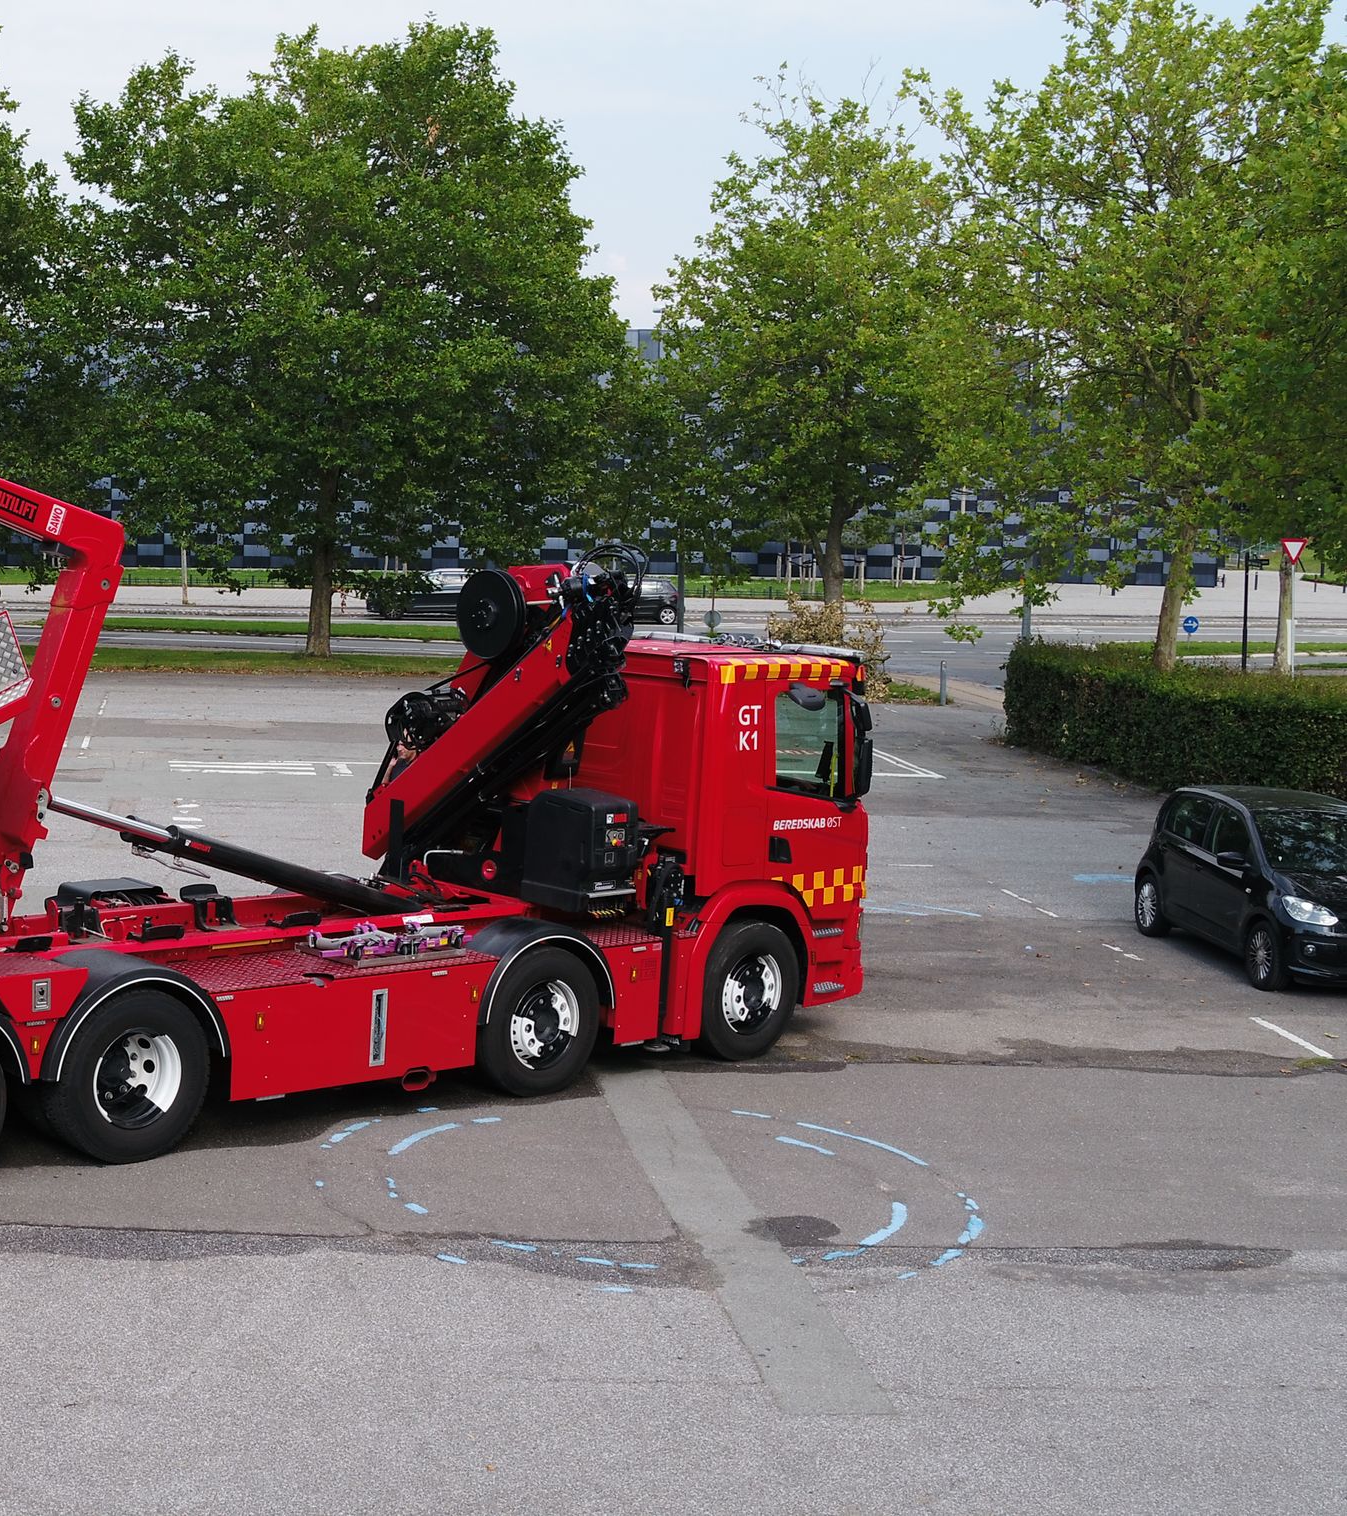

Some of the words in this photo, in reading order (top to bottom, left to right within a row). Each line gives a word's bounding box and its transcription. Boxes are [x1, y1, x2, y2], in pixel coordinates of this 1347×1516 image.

[48, 507, 63, 534] SAWO
[738, 704, 762, 726] GT
[739, 730, 758, 751] K1
[773, 817, 826, 831] BEREDSKAB
[826, 815, 843, 829] ØST
